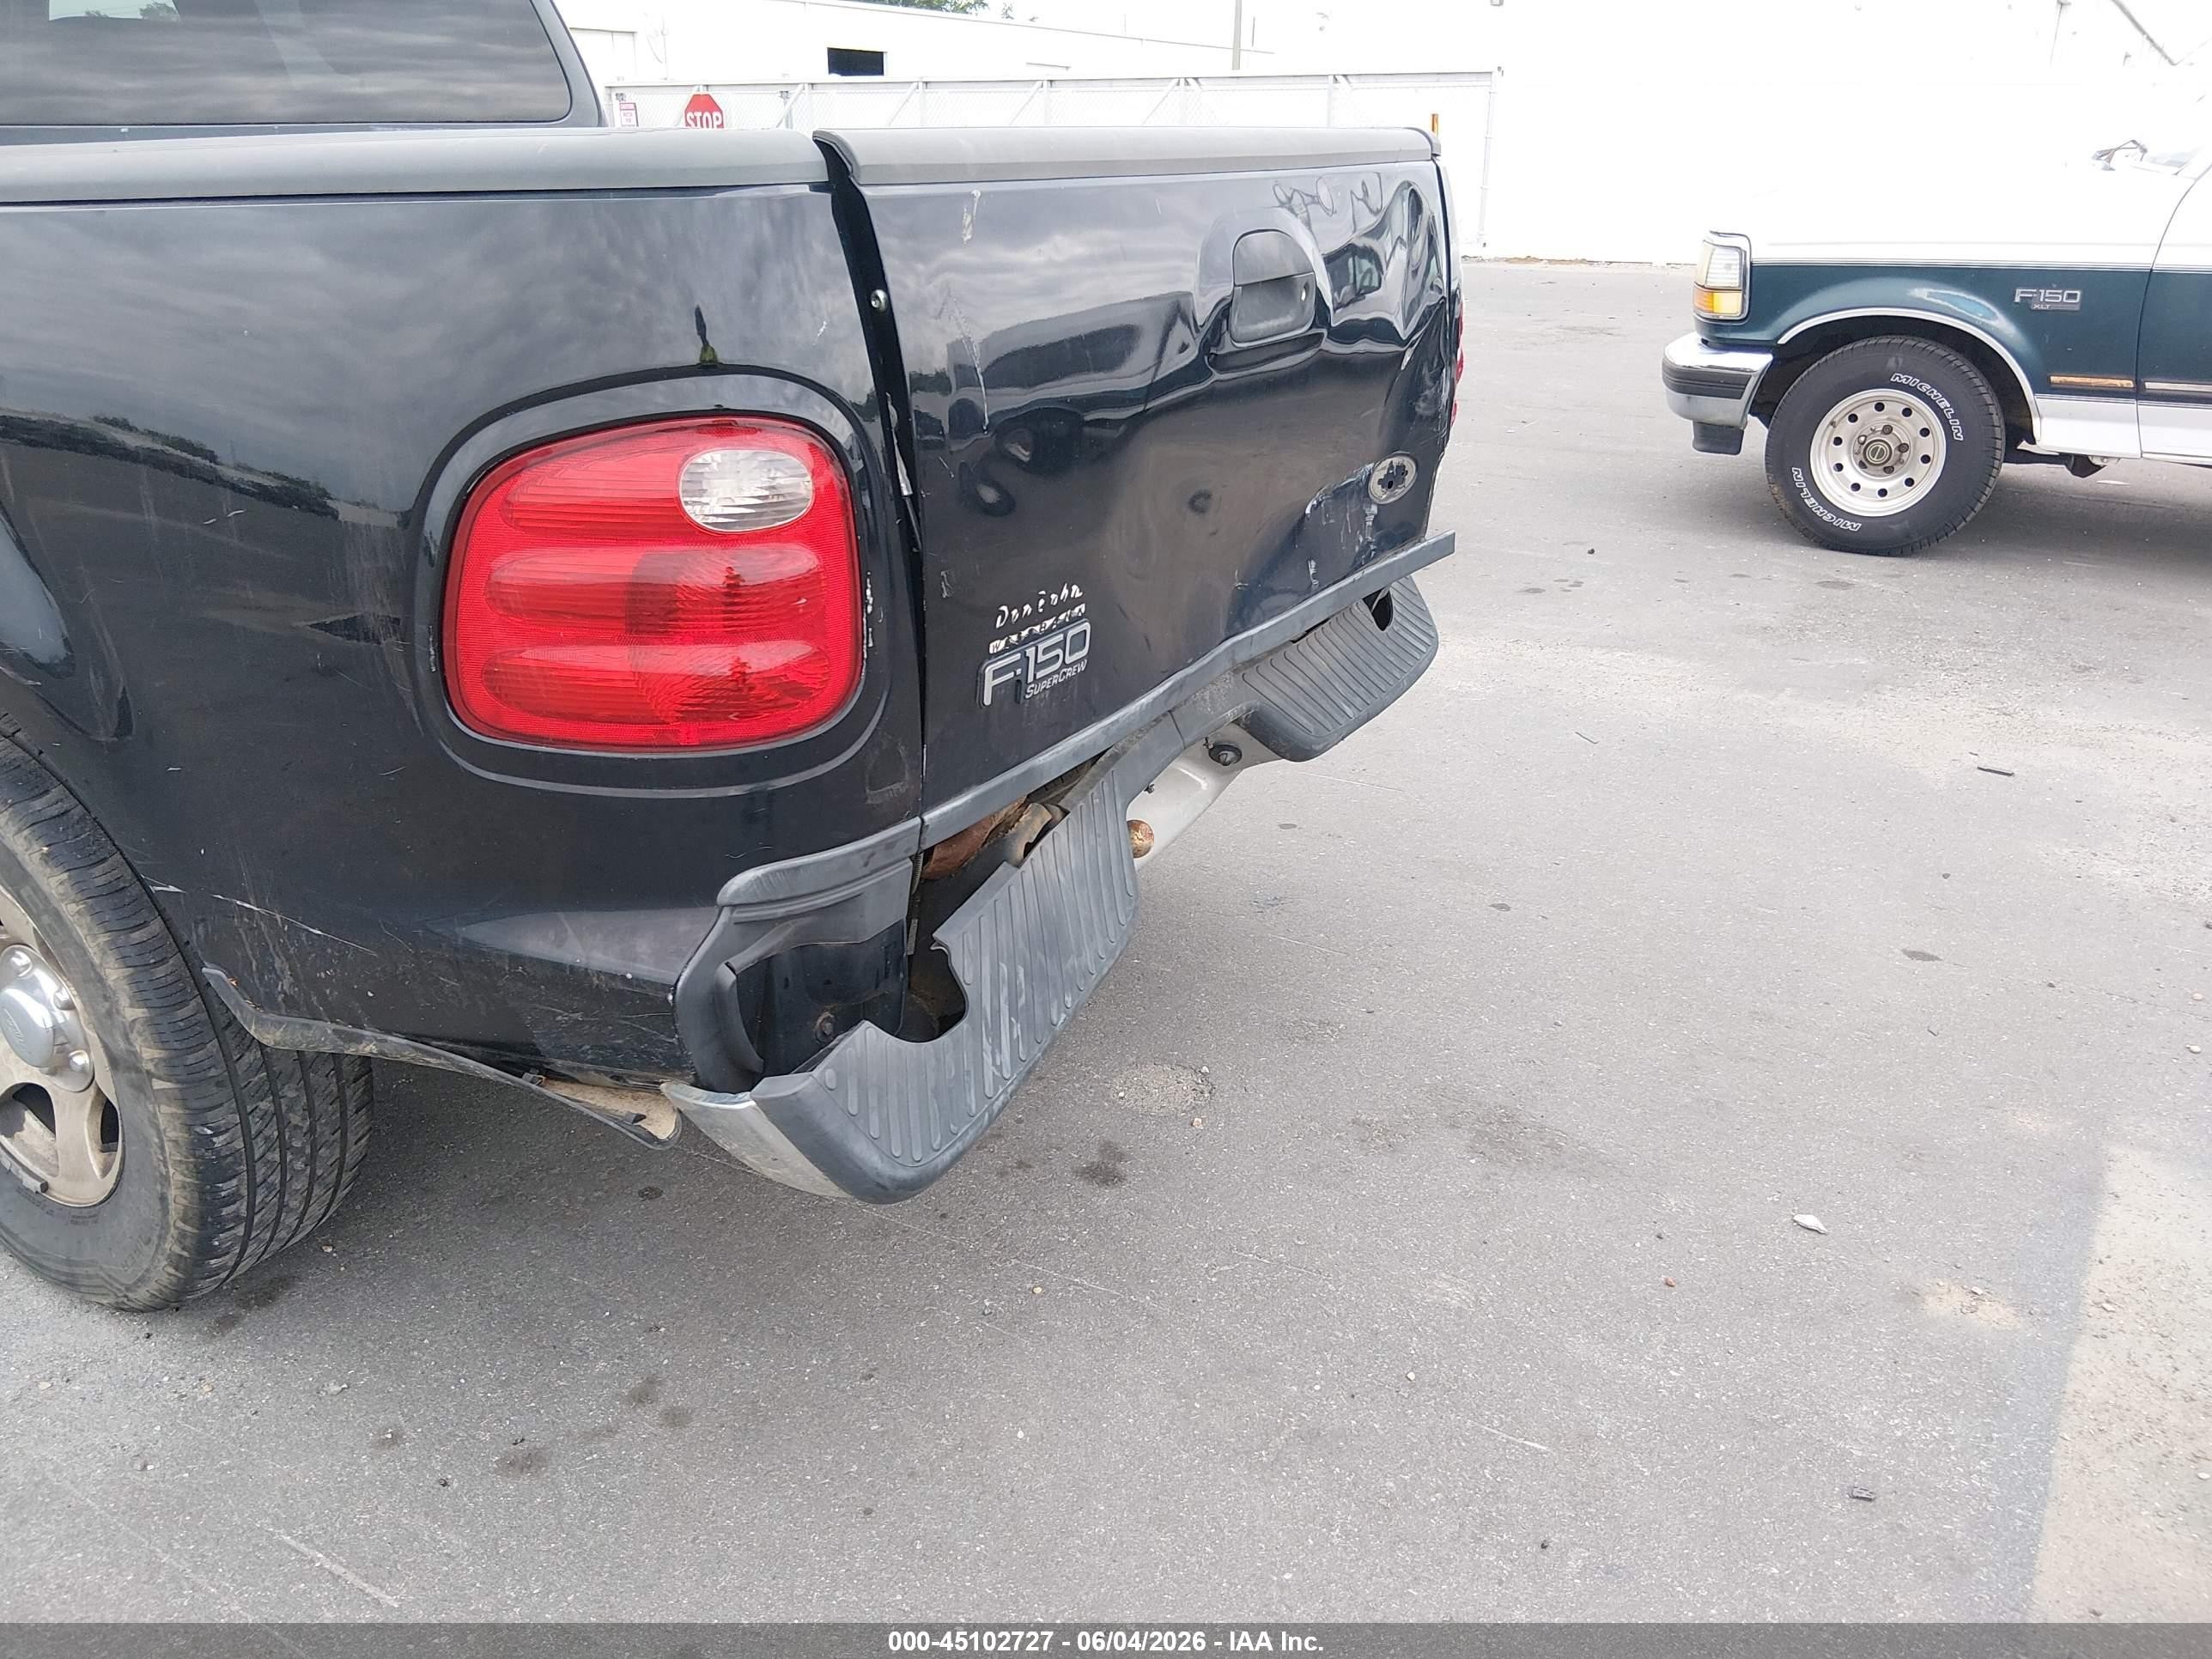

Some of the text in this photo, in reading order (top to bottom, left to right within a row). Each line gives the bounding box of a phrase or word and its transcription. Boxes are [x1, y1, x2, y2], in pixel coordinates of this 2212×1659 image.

[686, 111, 722, 129] STOP
[1890, 372, 1964, 441] MICHELIN
[1791, 466, 1863, 532] MICHELIN
